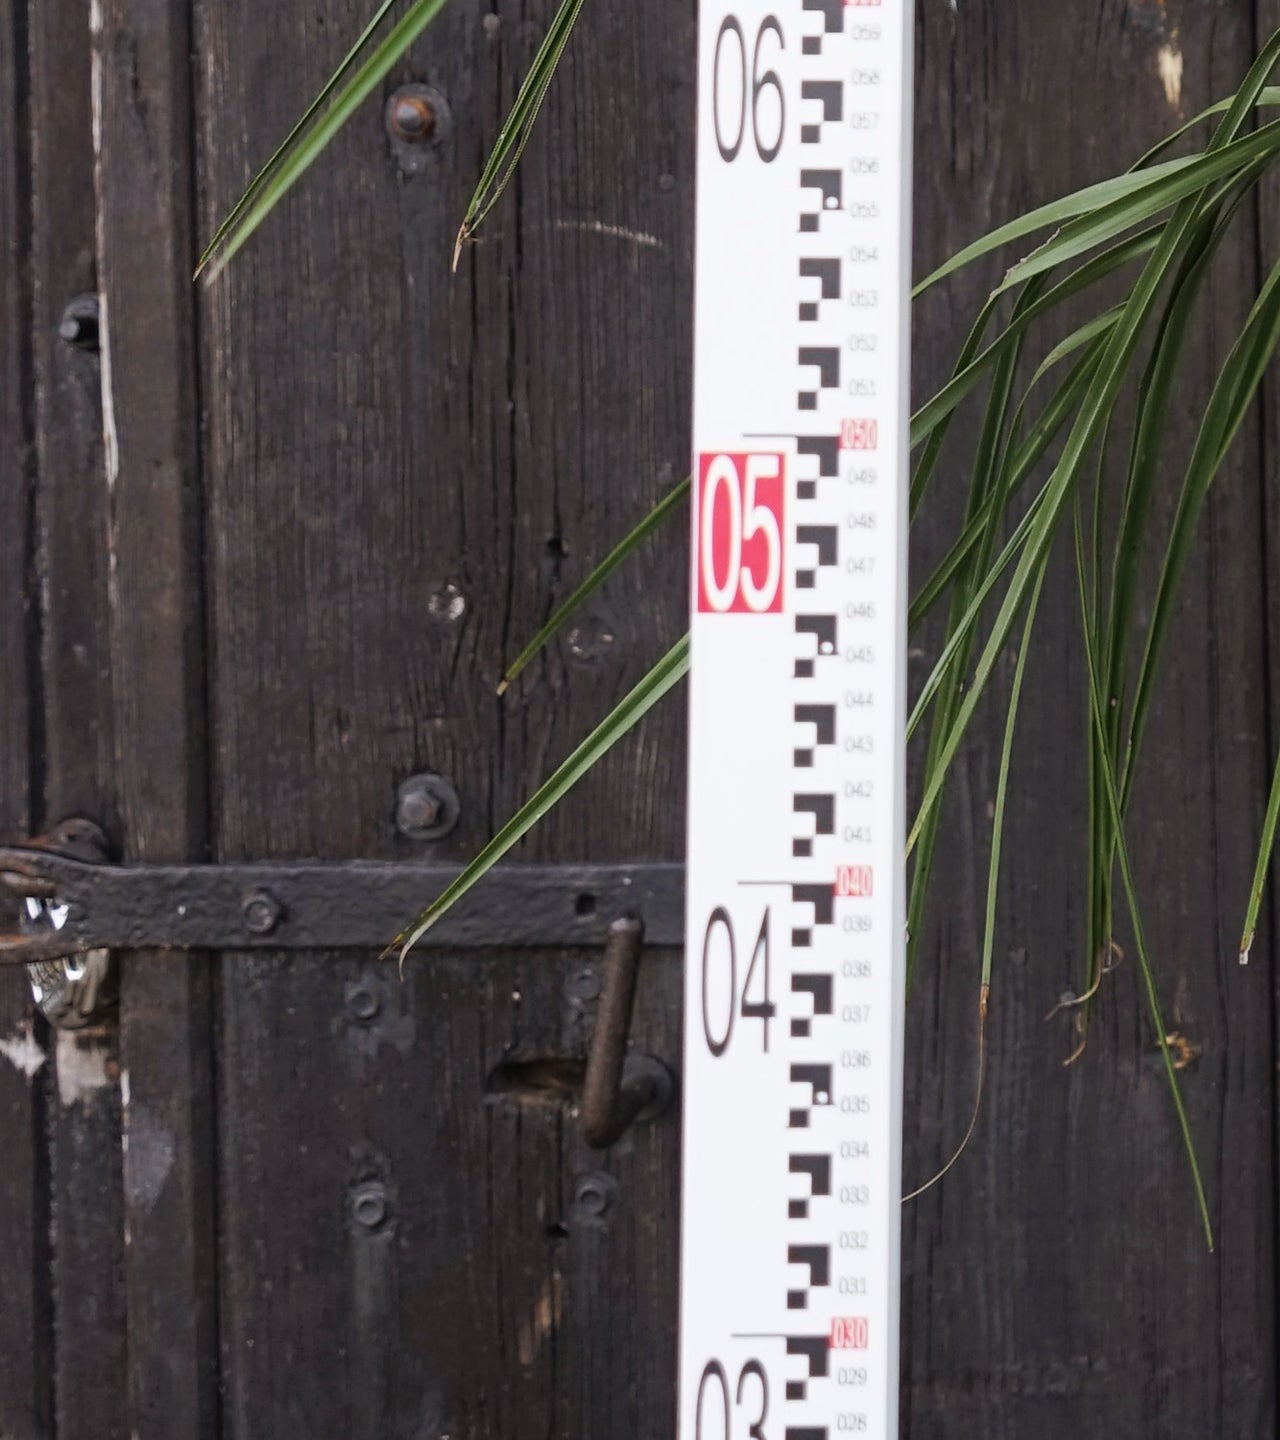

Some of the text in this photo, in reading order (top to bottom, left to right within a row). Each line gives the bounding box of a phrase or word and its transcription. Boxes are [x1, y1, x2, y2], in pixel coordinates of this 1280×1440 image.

[851, 23, 882, 41] 059
[851, 68, 881, 86] 058
[713, 14, 785, 163] 06
[850, 111, 880, 131] 057
[850, 156, 880, 175] 056
[849, 200, 880, 219] 055
[849, 245, 879, 263] 054
[847, 289, 879, 309] 053
[847, 333, 878, 353] 052
[846, 377, 877, 397] 051
[847, 468, 878, 485] 049
[846, 512, 877, 530] 048
[702, 454, 782, 612] 05
[845, 556, 875, 575] 047
[845, 601, 875, 619] 046
[844, 645, 876, 664] 045
[844, 691, 875, 709] 044
[843, 735, 874, 754] 043
[843, 780, 874, 799] 042
[842, 825, 873, 844] 041
[837, 867, 872, 896] 040
[841, 914, 873, 934] 039
[841, 959, 872, 979] 038
[701, 905, 776, 1057] 04
[840, 1004, 871, 1024] 037
[840, 1049, 872, 1069] 036
[839, 1095, 871, 1115] 035
[839, 1140, 870, 1159] 034
[838, 1184, 870, 1205] 033
[838, 1230, 869, 1251] 032
[837, 1275, 867, 1296] 031
[832, 1320, 867, 1348] 030
[836, 1366, 868, 1387] 029
[836, 1413, 868, 1432] 028
